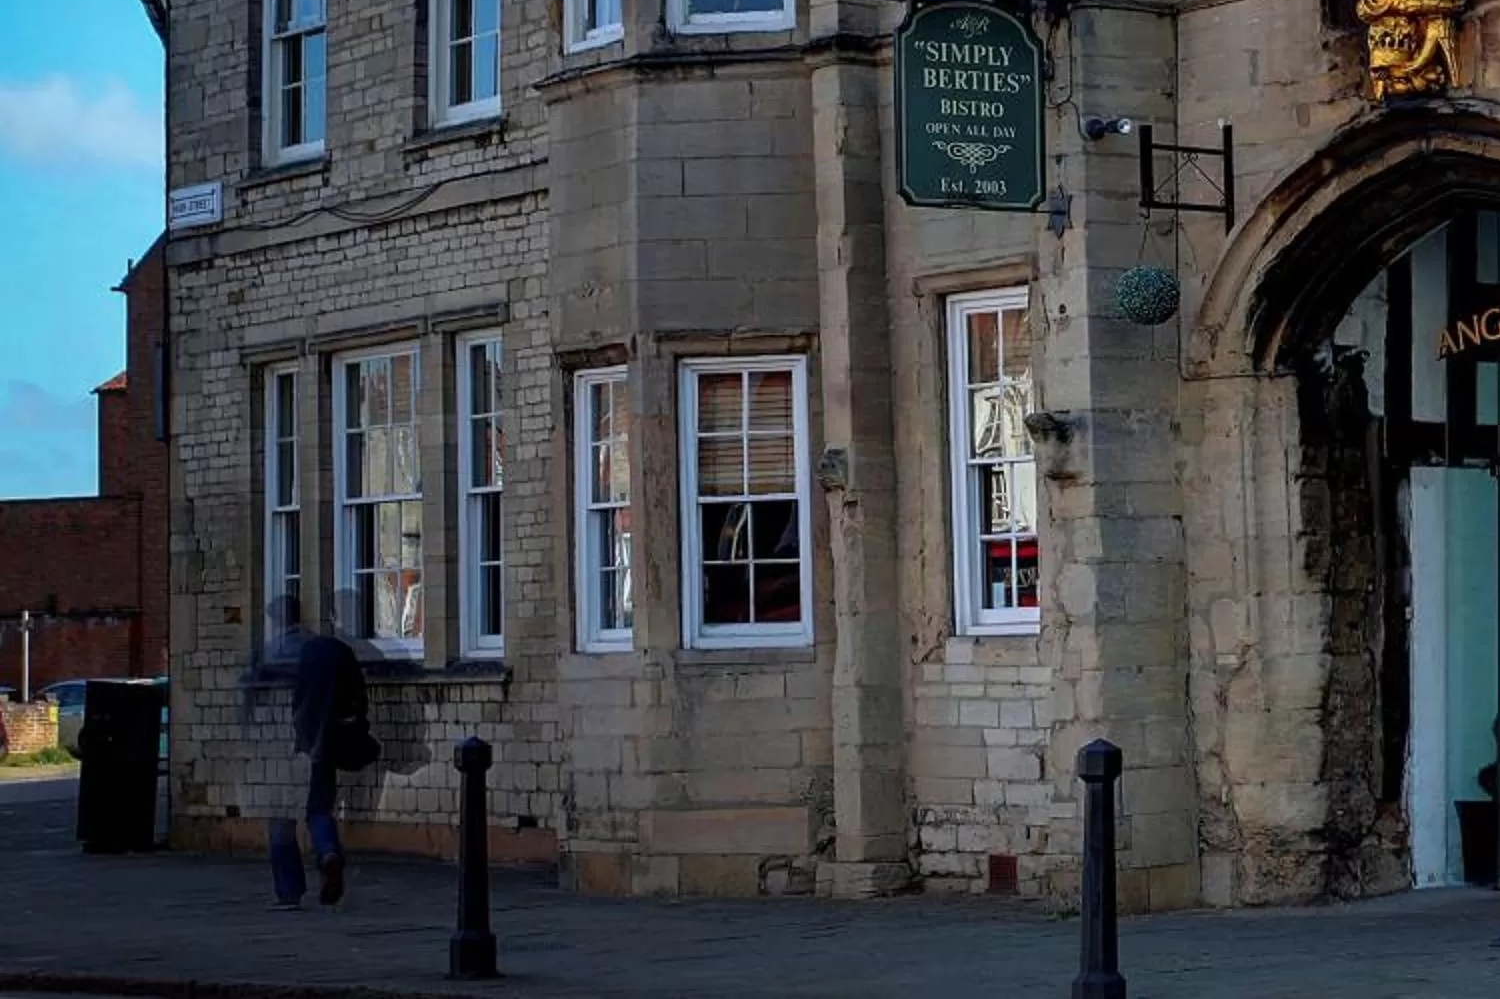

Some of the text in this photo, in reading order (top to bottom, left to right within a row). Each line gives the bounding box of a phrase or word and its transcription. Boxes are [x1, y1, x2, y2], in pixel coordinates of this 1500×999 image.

[940, 99, 1005, 119] BISTRO
[925, 122, 1017, 139] OPEN ALL DAY
[940, 178, 1007, 195] Est. 2003
